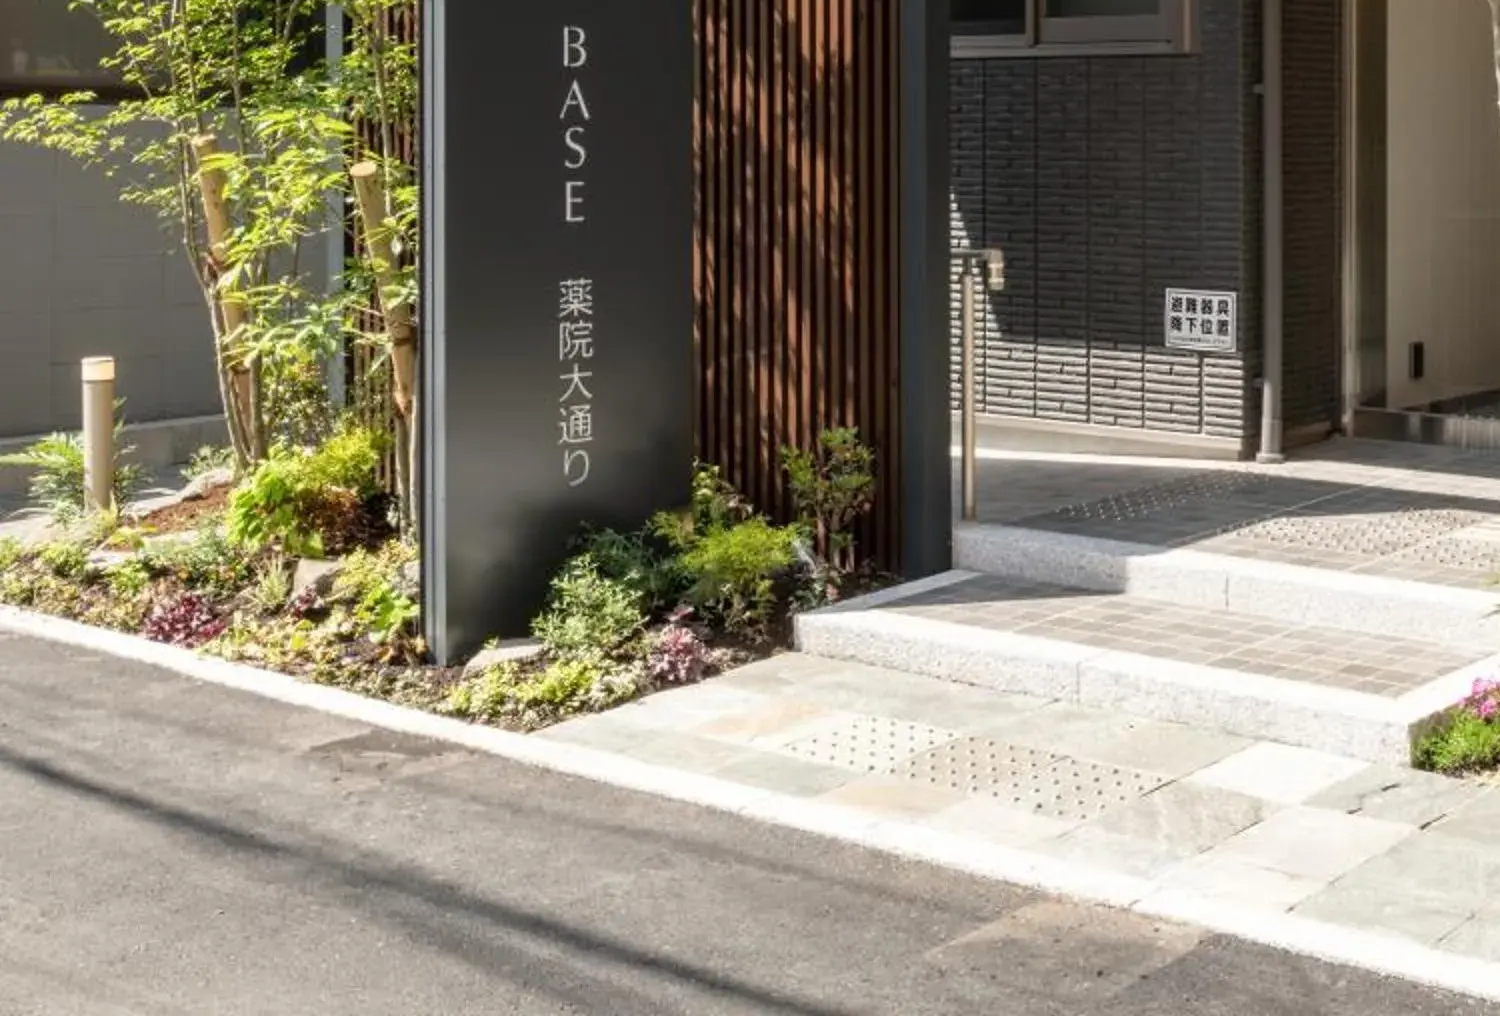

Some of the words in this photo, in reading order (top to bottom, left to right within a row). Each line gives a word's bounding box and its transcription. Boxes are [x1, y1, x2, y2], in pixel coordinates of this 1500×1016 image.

[559, 26, 590, 223] BASE
[558, 278, 594, 487] 薬院大通り
[1170, 315, 1229, 337] 降下位置
